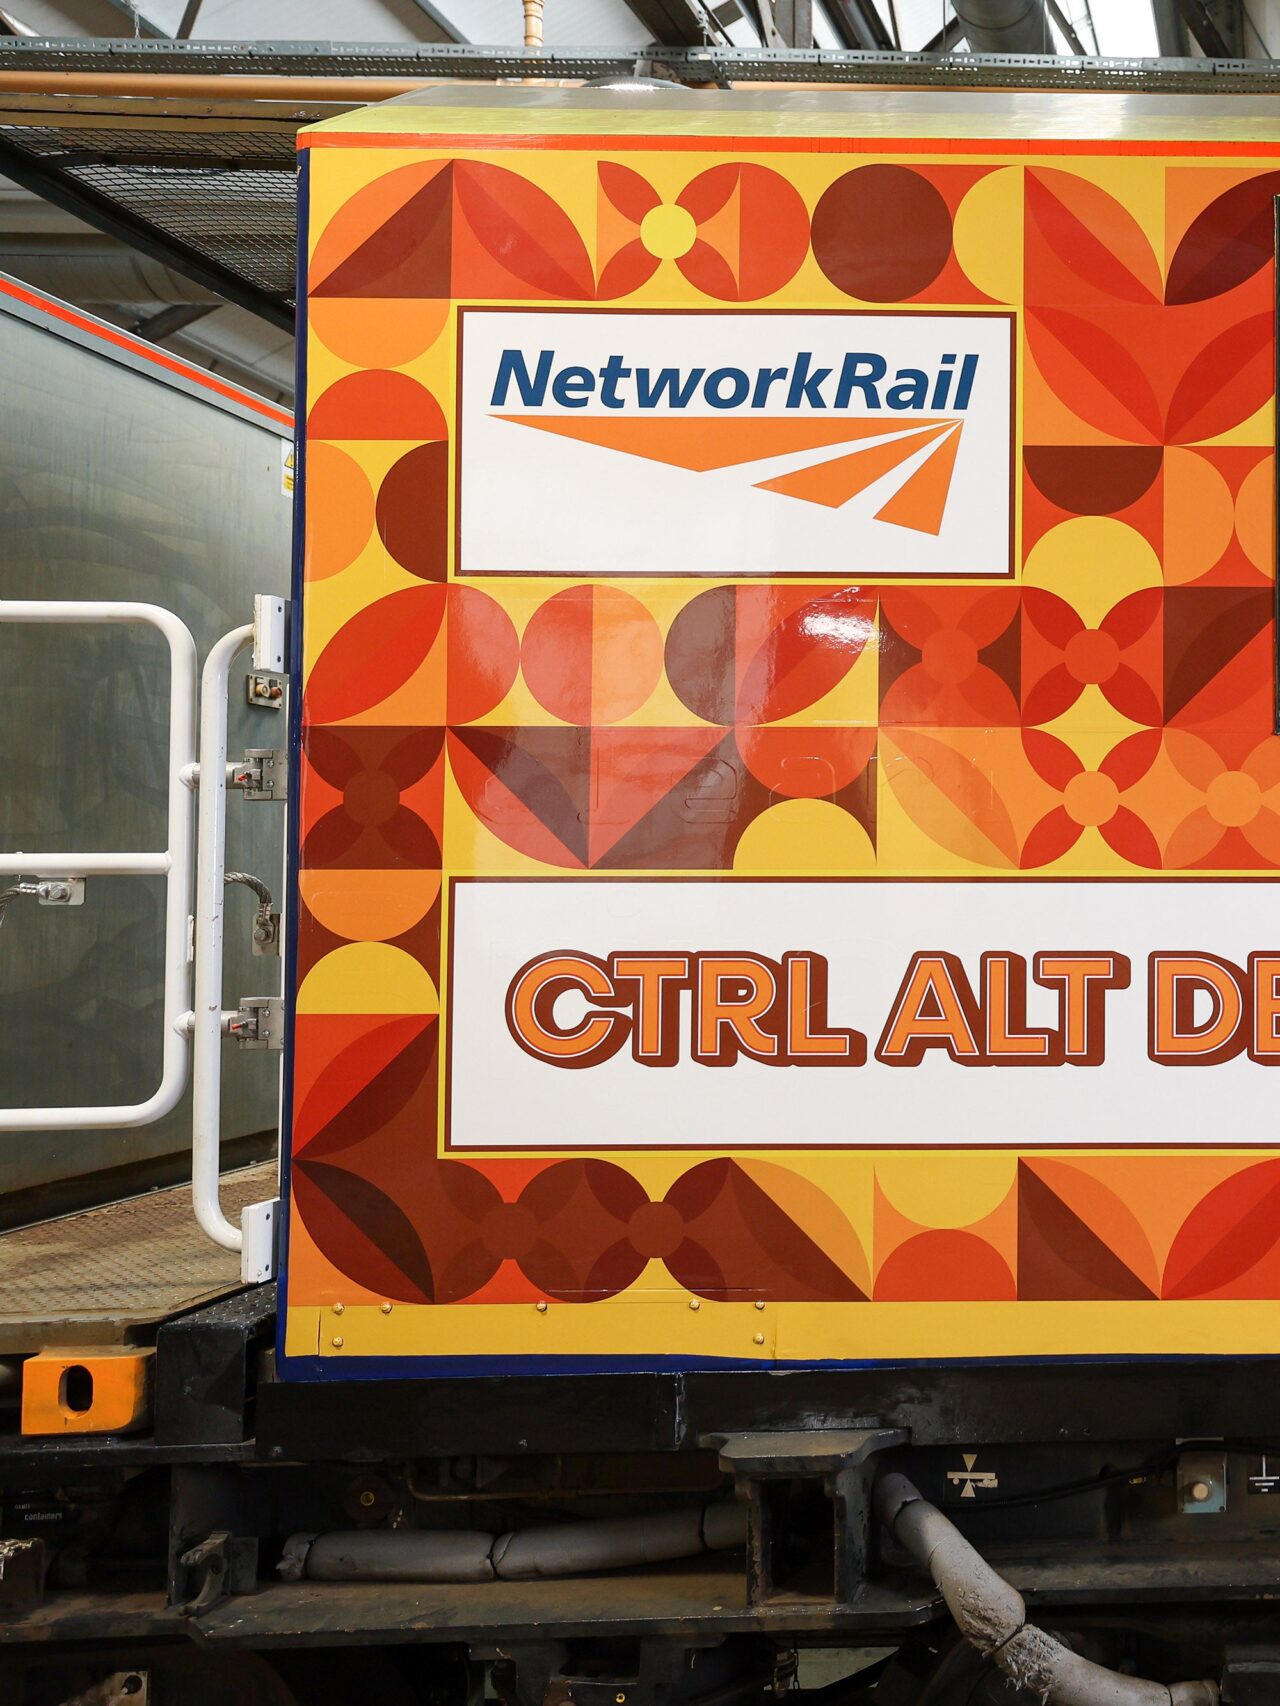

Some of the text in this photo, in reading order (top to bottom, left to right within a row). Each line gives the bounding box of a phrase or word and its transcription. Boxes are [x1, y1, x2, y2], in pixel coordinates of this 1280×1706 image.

[490, 349, 979, 411] NetworkRail
[504, 949, 868, 1070] CTRL
[873, 950, 1132, 1068] ALT
